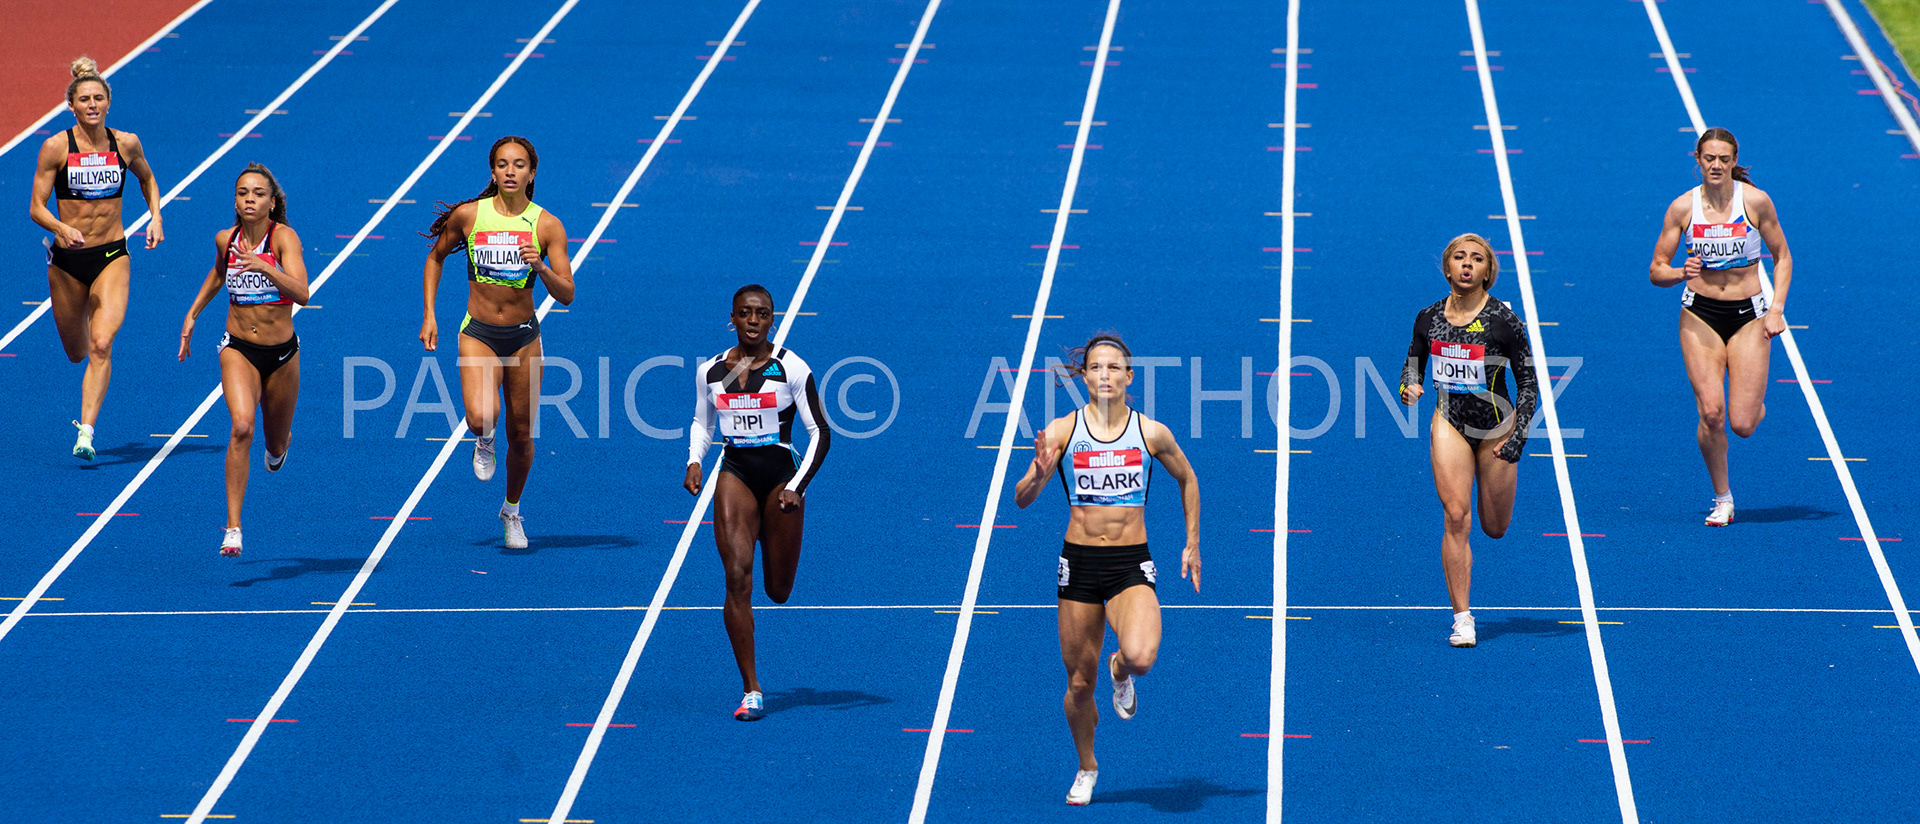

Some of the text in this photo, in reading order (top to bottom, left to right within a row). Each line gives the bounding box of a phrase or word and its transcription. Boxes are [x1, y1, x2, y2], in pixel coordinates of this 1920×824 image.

[80, 153, 107, 167] müller
[70, 170, 120, 185] HILLYARD
[487, 231, 520, 245] müller
[1704, 224, 1734, 238] müller
[1694, 241, 1746, 257] MCAULAY
[476, 250, 530, 265] WILLIAM
[1440, 344, 1471, 359] müller
[1436, 361, 1479, 380] JOHN
[728, 394, 762, 409] müller
[733, 414, 763, 431] PIPI
[733, 435, 774, 445] BIRMINGHAM
[1088, 450, 1127, 468] müller
[1077, 472, 1141, 490] CLARK
